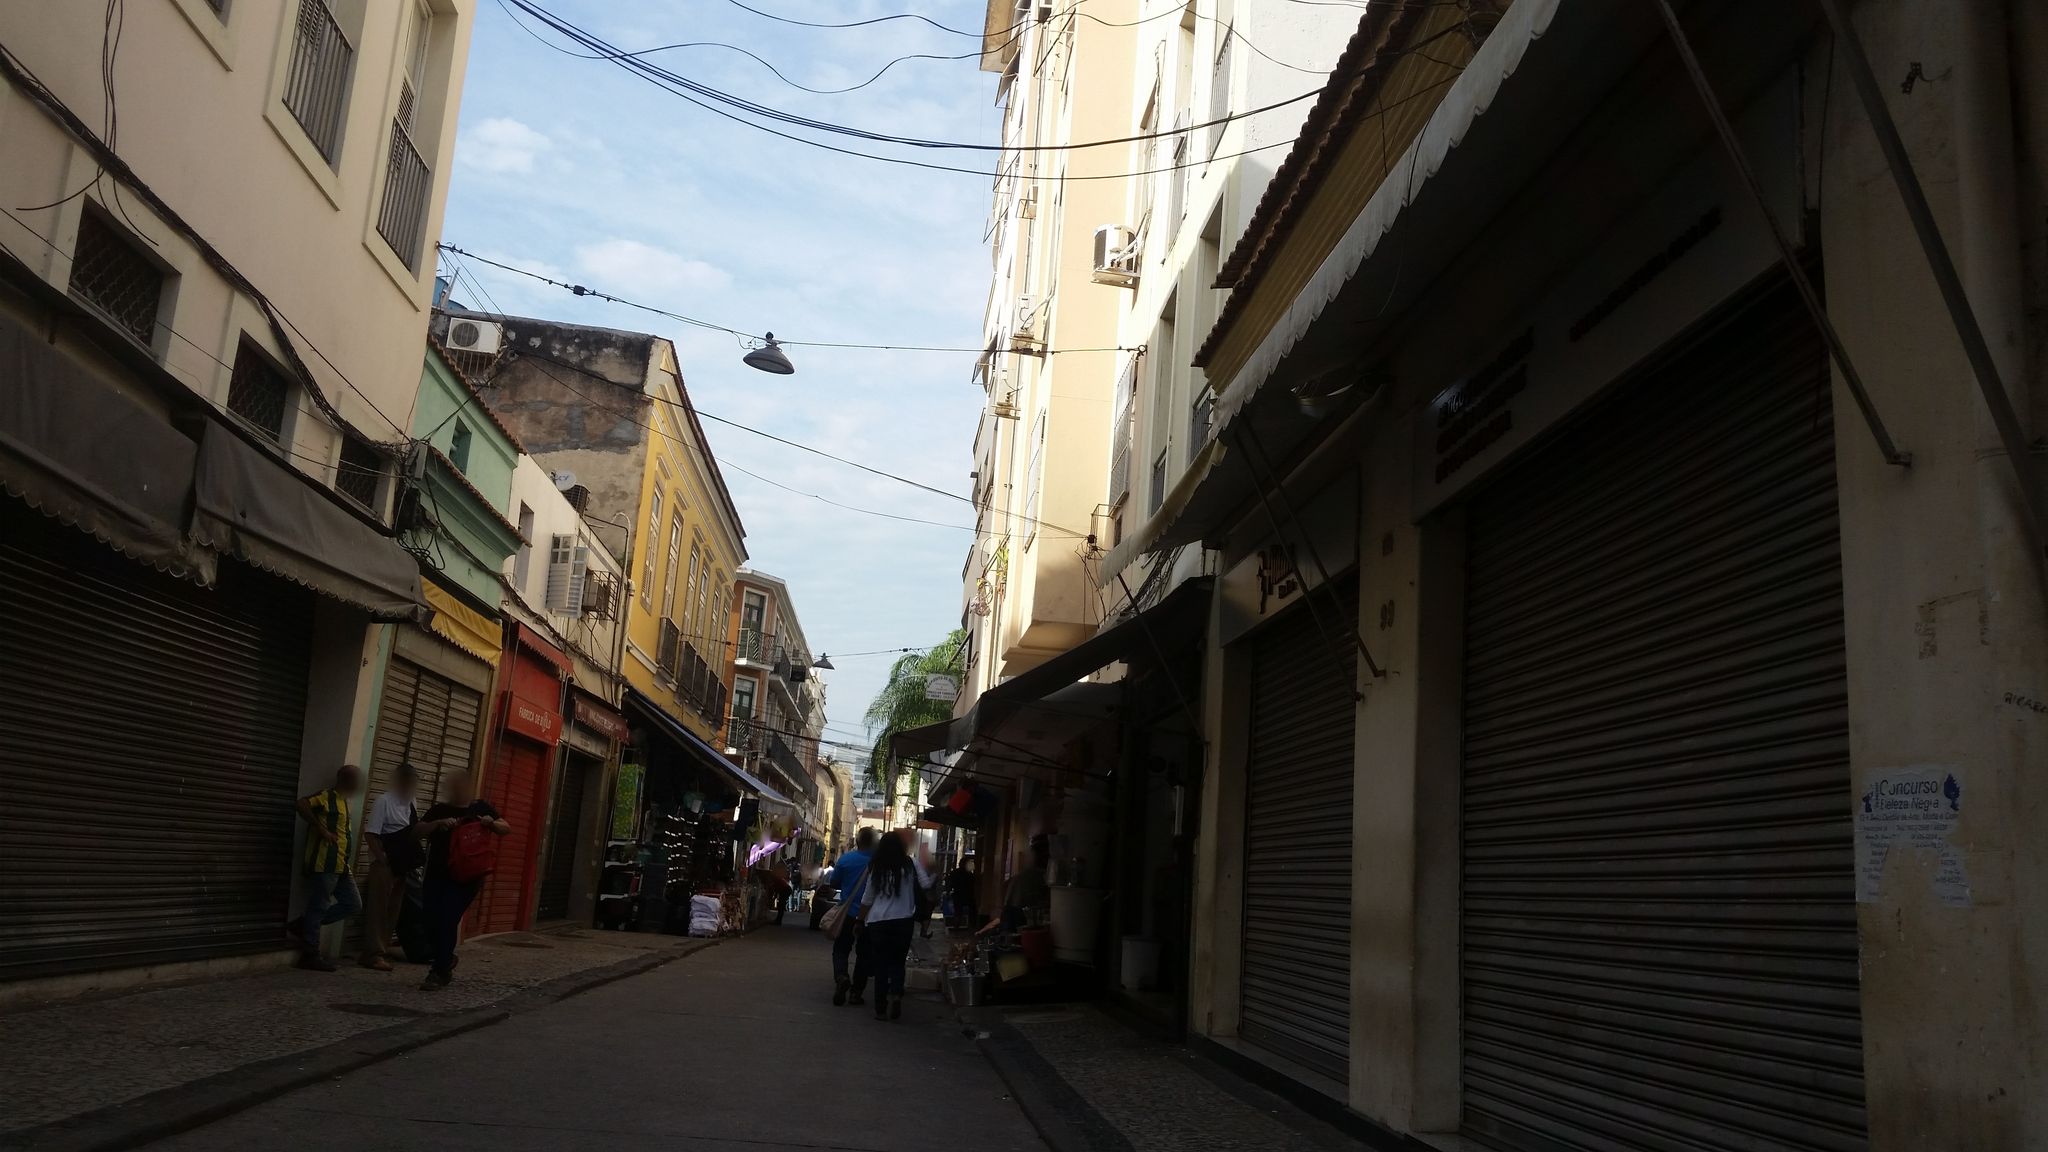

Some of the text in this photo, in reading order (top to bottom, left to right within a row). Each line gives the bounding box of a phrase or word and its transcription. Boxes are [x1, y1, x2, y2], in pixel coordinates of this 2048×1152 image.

[540, 714, 552, 730] BOLO
[1879, 779, 1938, 796] Concurso
[1880, 797, 1939, 811] Beleza Negra
